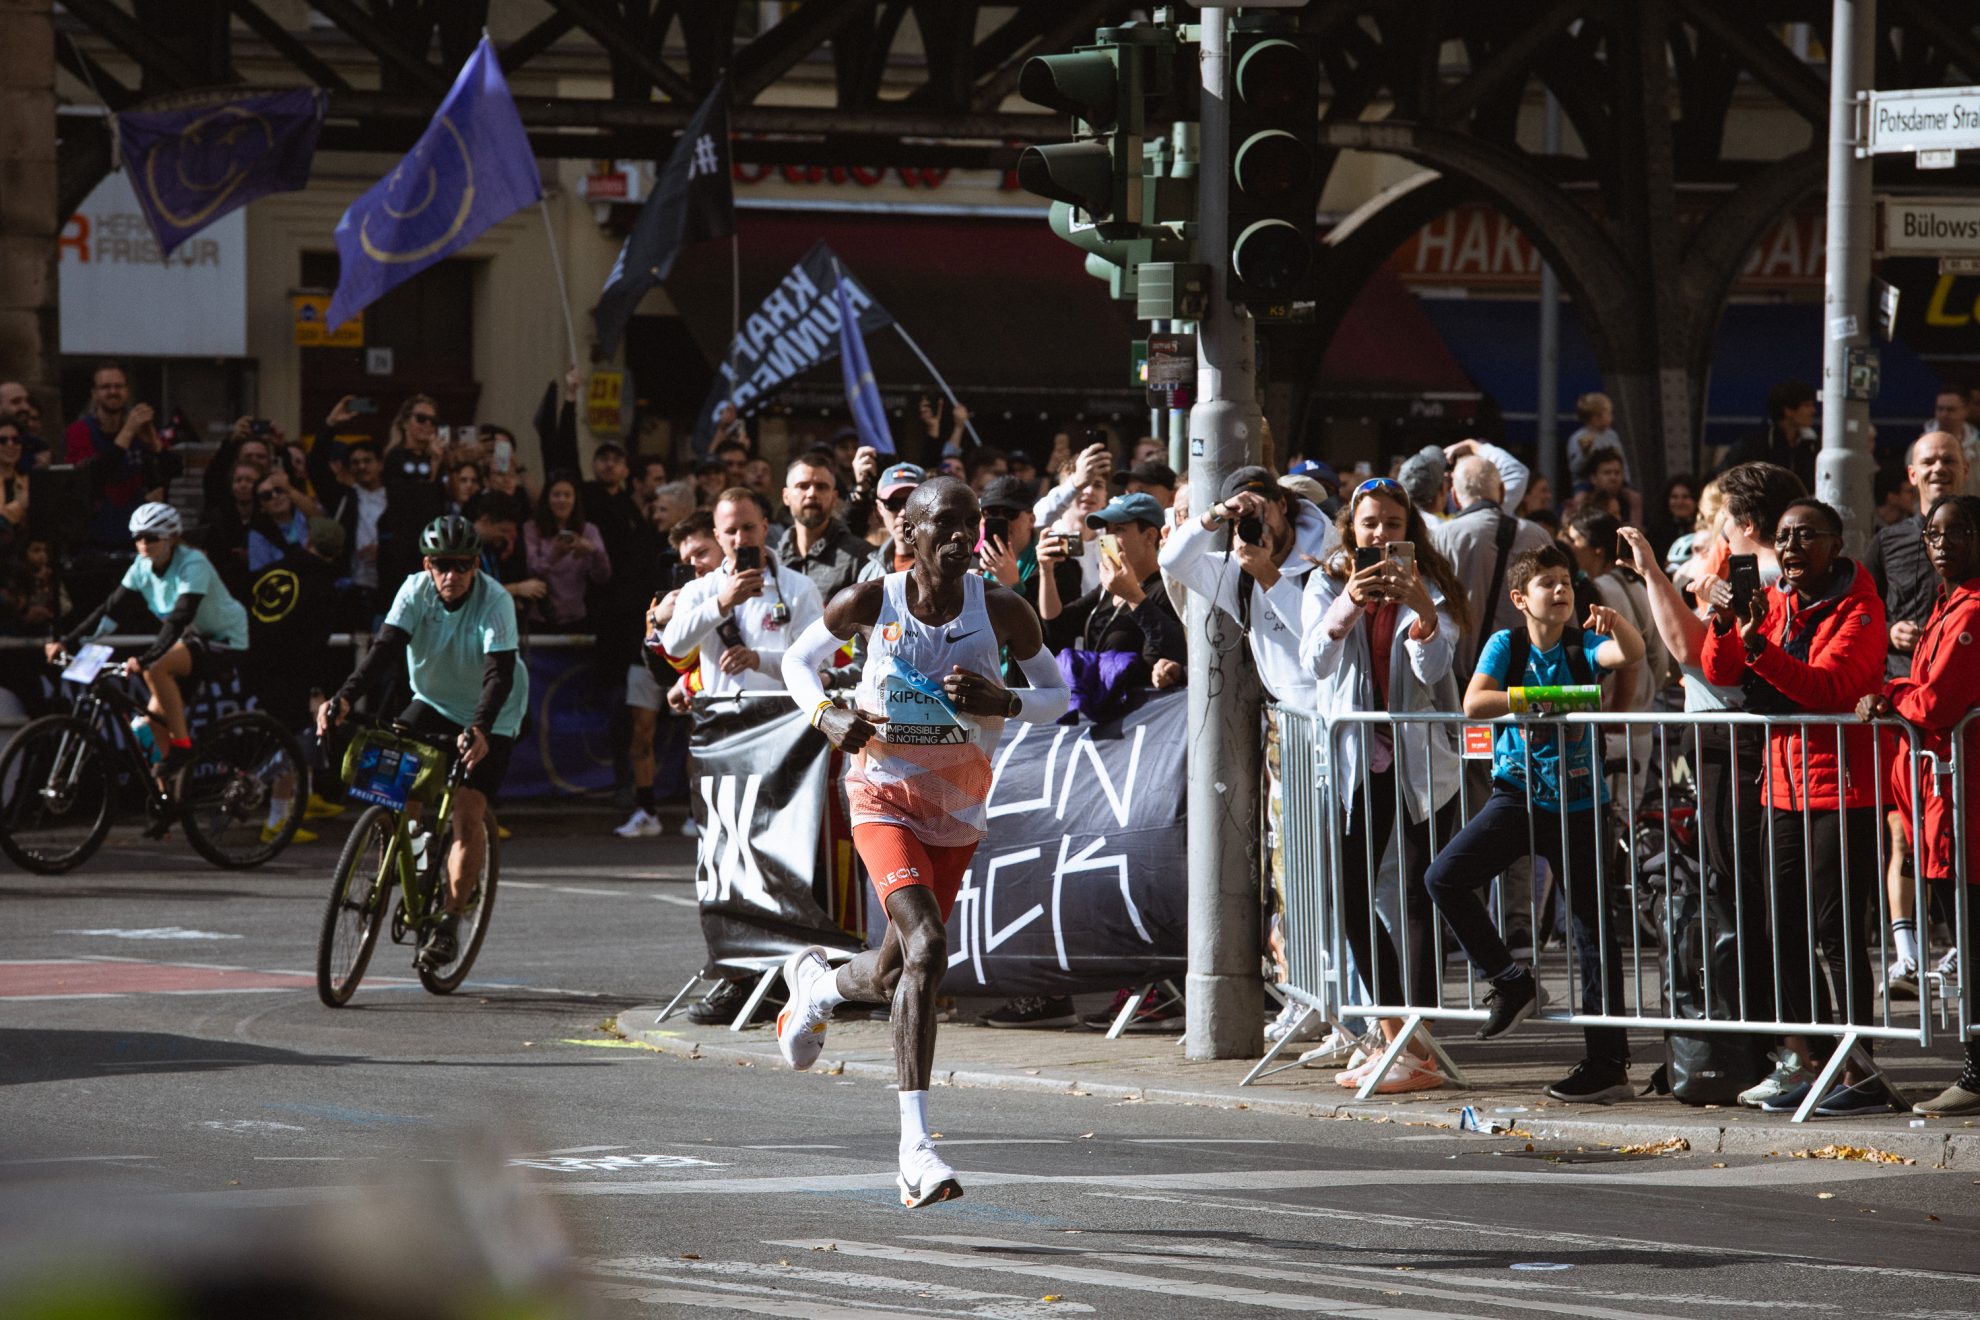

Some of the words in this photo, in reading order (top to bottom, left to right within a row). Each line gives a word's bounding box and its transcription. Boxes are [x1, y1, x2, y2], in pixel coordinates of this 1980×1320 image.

[1880, 107, 1949, 132] Potsdamer
[1952, 103, 1980, 129] Stra
[1903, 211, 1980, 238] Bülows
[96, 239, 221, 266] FRISUR
[887, 725, 941, 734] IMPOSSIBLE
[887, 735, 894, 743] IS
[895, 734, 938, 744] NOTHING
[986, 721, 1146, 828] UN
[350, 787, 374, 802] FREIE
[376, 796, 403, 810] FAHRT
[877, 867, 920, 895] INEOS
